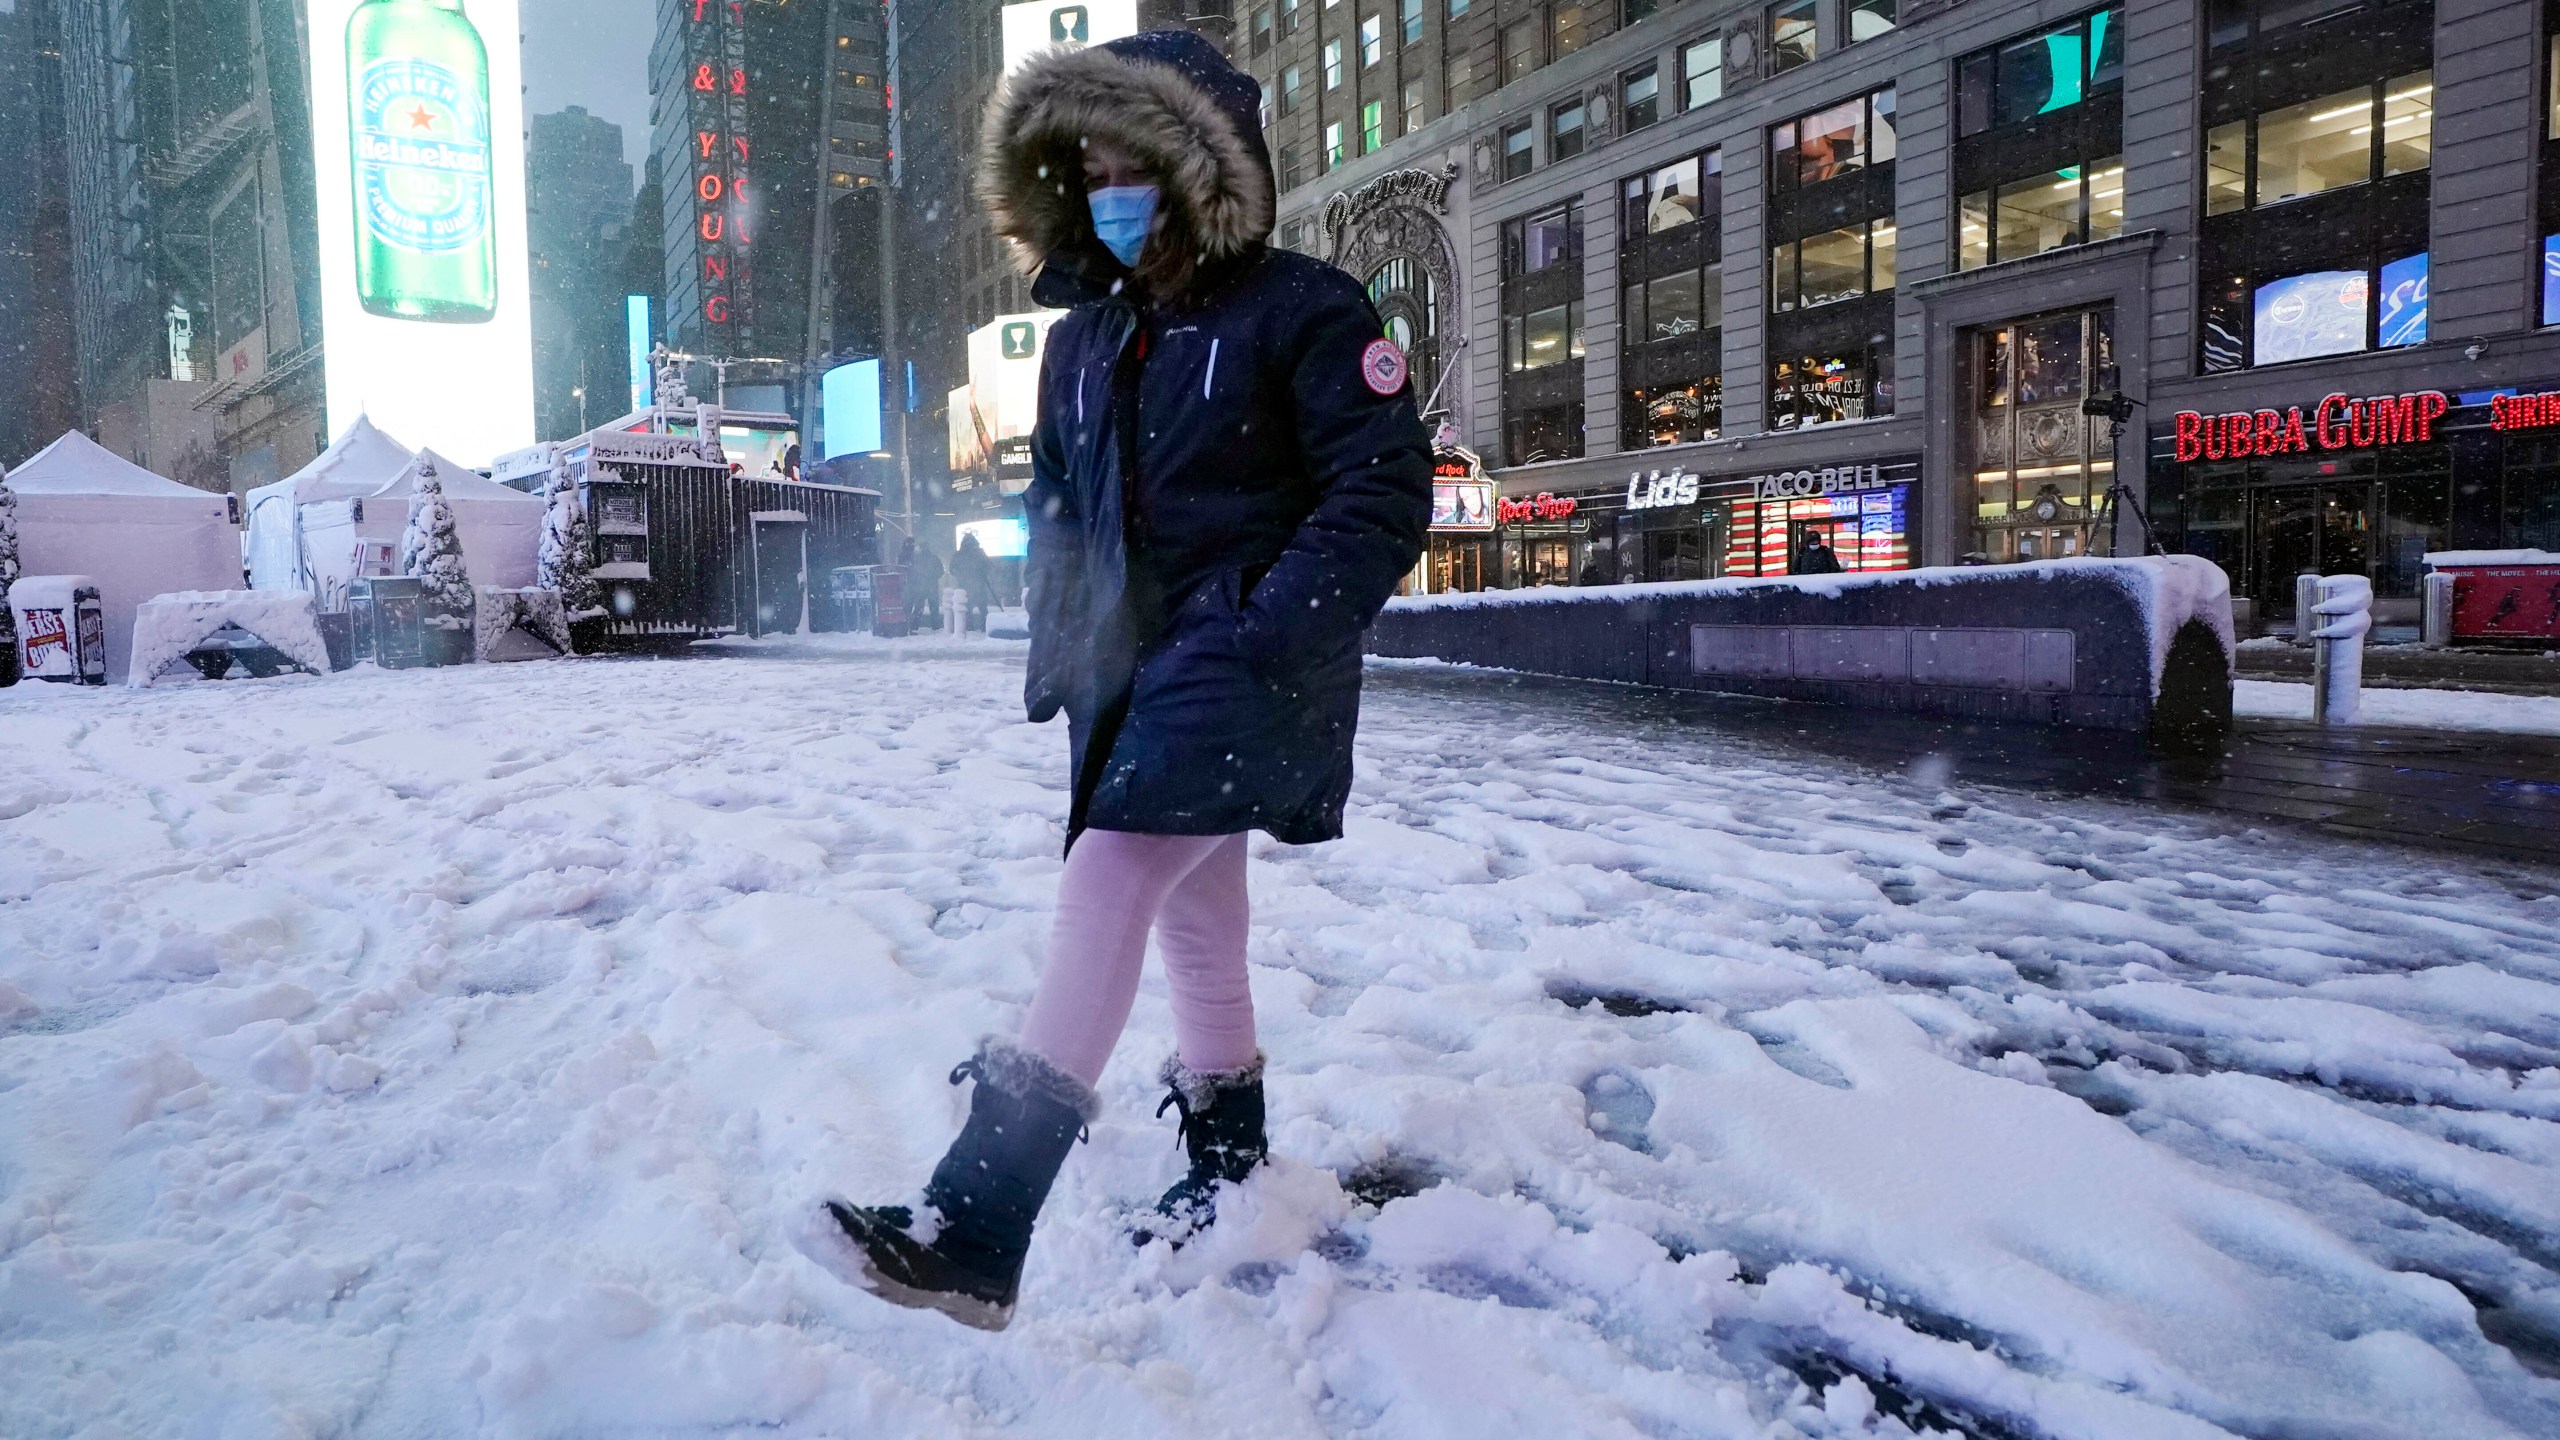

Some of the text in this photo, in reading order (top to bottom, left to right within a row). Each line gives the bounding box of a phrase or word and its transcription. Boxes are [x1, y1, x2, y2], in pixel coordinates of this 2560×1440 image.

[694, 65, 715, 91] &
[358, 134, 486, 172] Heineken
[699, 131, 728, 323] YOUNG
[1322, 160, 1458, 263] Paramount
[2174, 391, 2448, 463] BUBBA GUMP
[1001, 453, 1033, 465] GAMBLI
[1435, 464, 1465, 477] rd Rock
[1626, 467, 1700, 510] Lids
[1748, 464, 1887, 503] TACO BELL
[1497, 491, 1577, 524] Rock Shop
